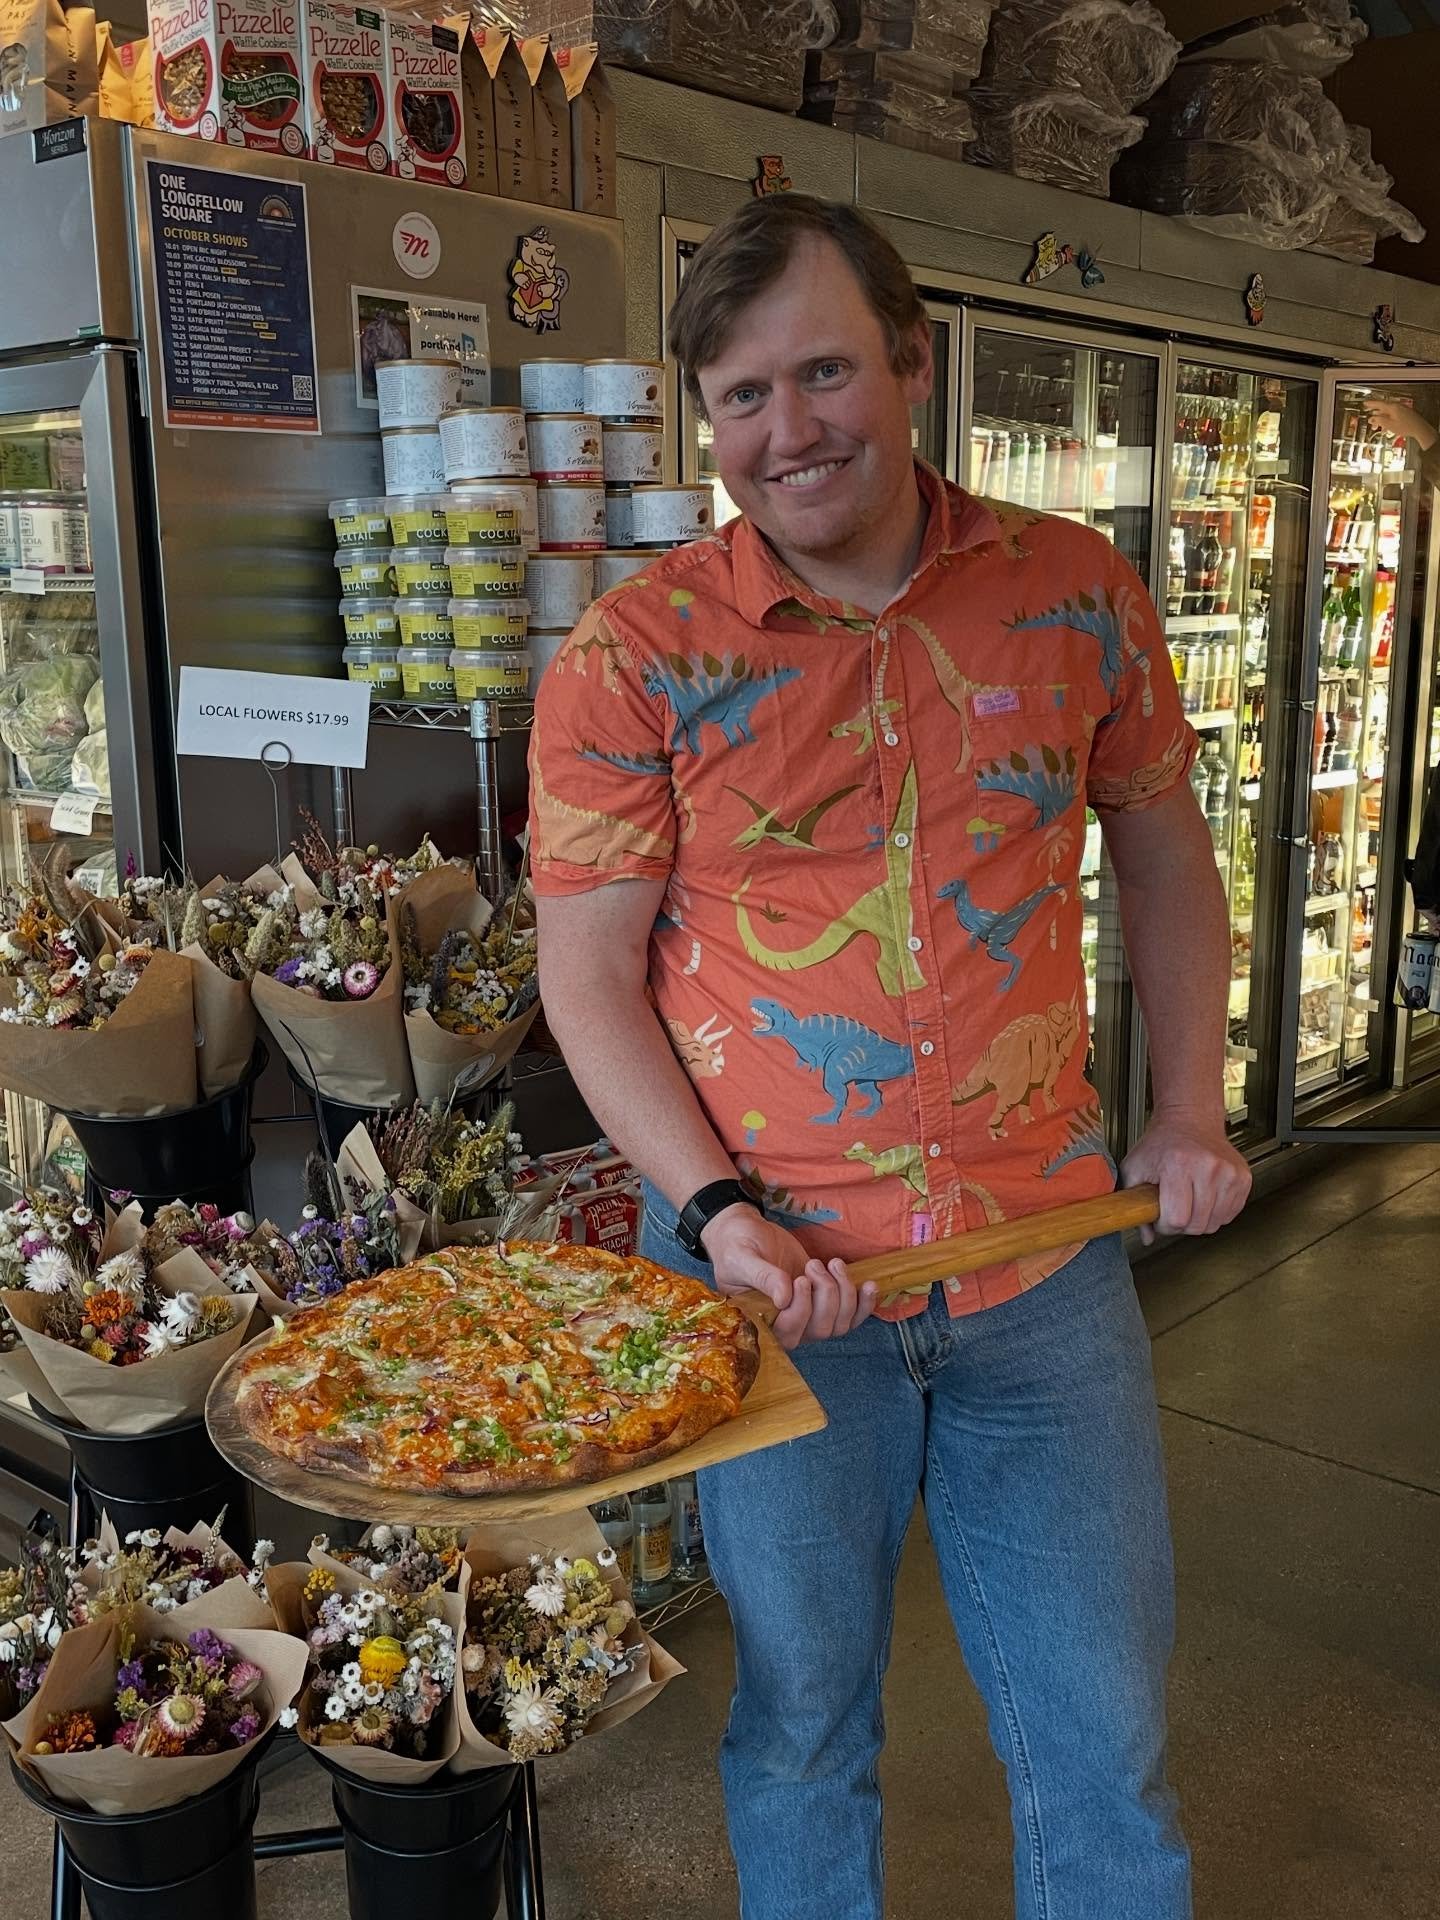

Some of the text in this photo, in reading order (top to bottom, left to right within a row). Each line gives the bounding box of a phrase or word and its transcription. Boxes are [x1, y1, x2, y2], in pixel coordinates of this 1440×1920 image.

[217, 3, 295, 34] Pizzelle
[308, 2, 336, 21] Pepi's
[390, 23, 415, 42] Pepi's
[233, 36, 288, 48] Waffle Cookies
[310, 26, 382, 57] Pizzelle
[325, 57, 375, 71] Waffle Cookies
[391, 46, 458, 76] Pizzelle
[406, 77, 450, 89] Waffle Cookies
[42, 127, 76, 147] Horizon
[50, 144, 69, 154] SERIES
[476, 129, 485, 179] MAINE
[512, 138, 522, 186] MAINE
[550, 147, 560, 195] MAINE
[593, 154, 604, 201] MAINE
[159, 173, 186, 190] ONE
[160, 188, 244, 214] LONGFELLOW
[161, 203, 213, 224] SQUARE
[163, 226, 248, 248] OCTOBER SHOWS
[195, 254, 216, 264] CACTUS
[186, 298, 215, 307] PORTLAND
[230, 303, 261, 312] ORCHESTRA
[414, 307, 480, 323] vailable Here!
[229, 345, 252, 354] PROJECT
[229, 354, 252, 363] PROJECT
[337, 531, 374, 543] OCKTAIL
[416, 528, 447, 539] COCK
[479, 528, 520, 540] COCKTA
[342, 582, 370, 591] CKTAIL
[415, 580, 449, 591] COCKT
[347, 631, 382, 641] OCKTAIL
[420, 630, 451, 641] COCK
[486, 684, 526, 695] COCKTA
[199, 704, 349, 726] LOCAL FLOWERS $17.99
[595, 1234, 630, 1251] STACHI
